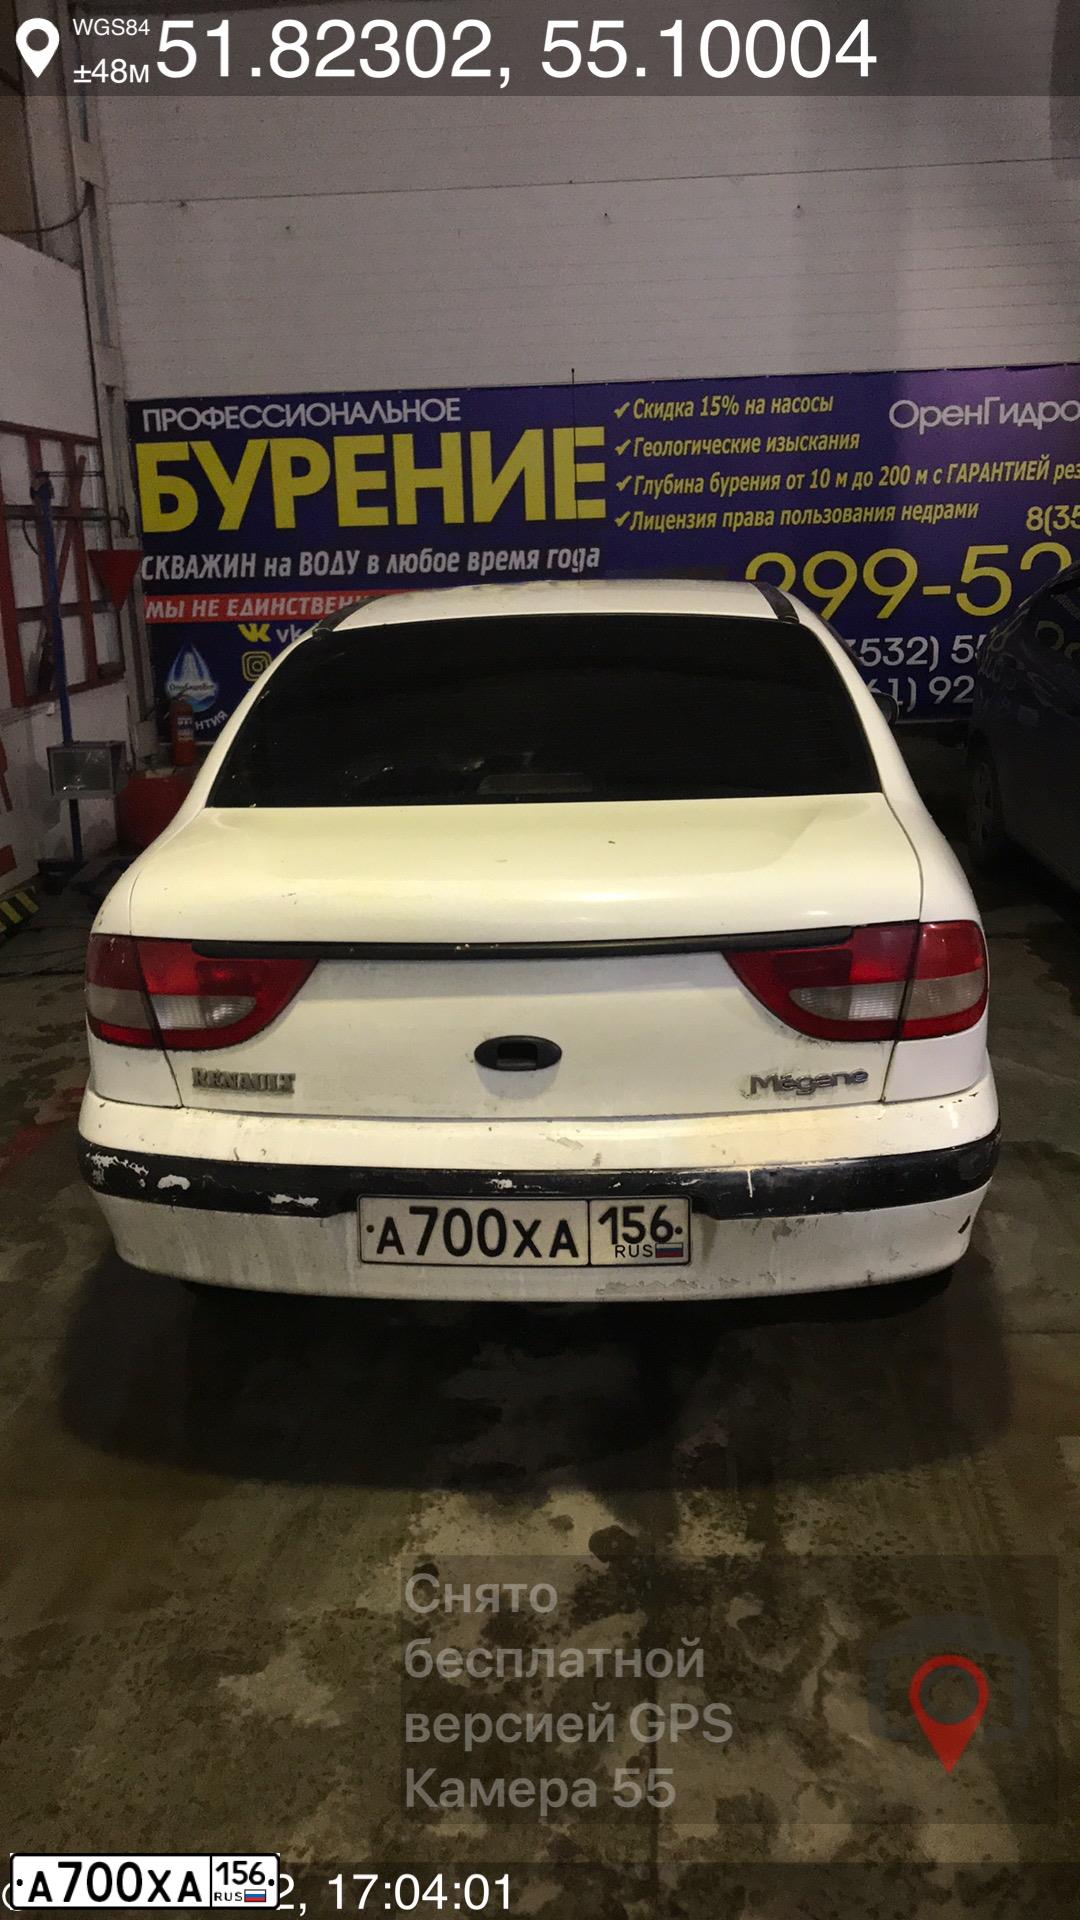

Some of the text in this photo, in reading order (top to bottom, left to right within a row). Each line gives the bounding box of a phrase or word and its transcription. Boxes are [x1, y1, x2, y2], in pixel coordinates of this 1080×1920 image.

[142, 397, 461, 433] ПРОФЕССИОНАЛЬНОЕ
[632, 395, 834, 421] Скидка 15% на насосы
[633, 432, 860, 458] Геологические изыскания
[135, 426, 606, 534] БУРЕНИЕ
[633, 473, 704, 500] Глубина
[709, 471, 781, 498] бурения
[786, 473, 805, 490] от
[809, 468, 831, 489] 10
[835, 472, 848, 488] м
[851, 470, 874, 491] до
[878, 464, 911, 487] 200
[915, 469, 928, 485] м
[946, 453, 1050, 484] ГАРАНТИЕЙ
[629, 502, 980, 533] Лицензия права пользования недрами
[141, 547, 600, 581] СКВАЖИН на ВОДУ в любое время года
[146, 600, 185, 619] МЫ
[192, 599, 220, 618] НЕ
[195, 709, 229, 731] НТИЯ
[191, 1068, 296, 1094] RENAULT
[376, 1205, 673, 1259] А700ХА 156
[615, 1244, 654, 1258] RUS
